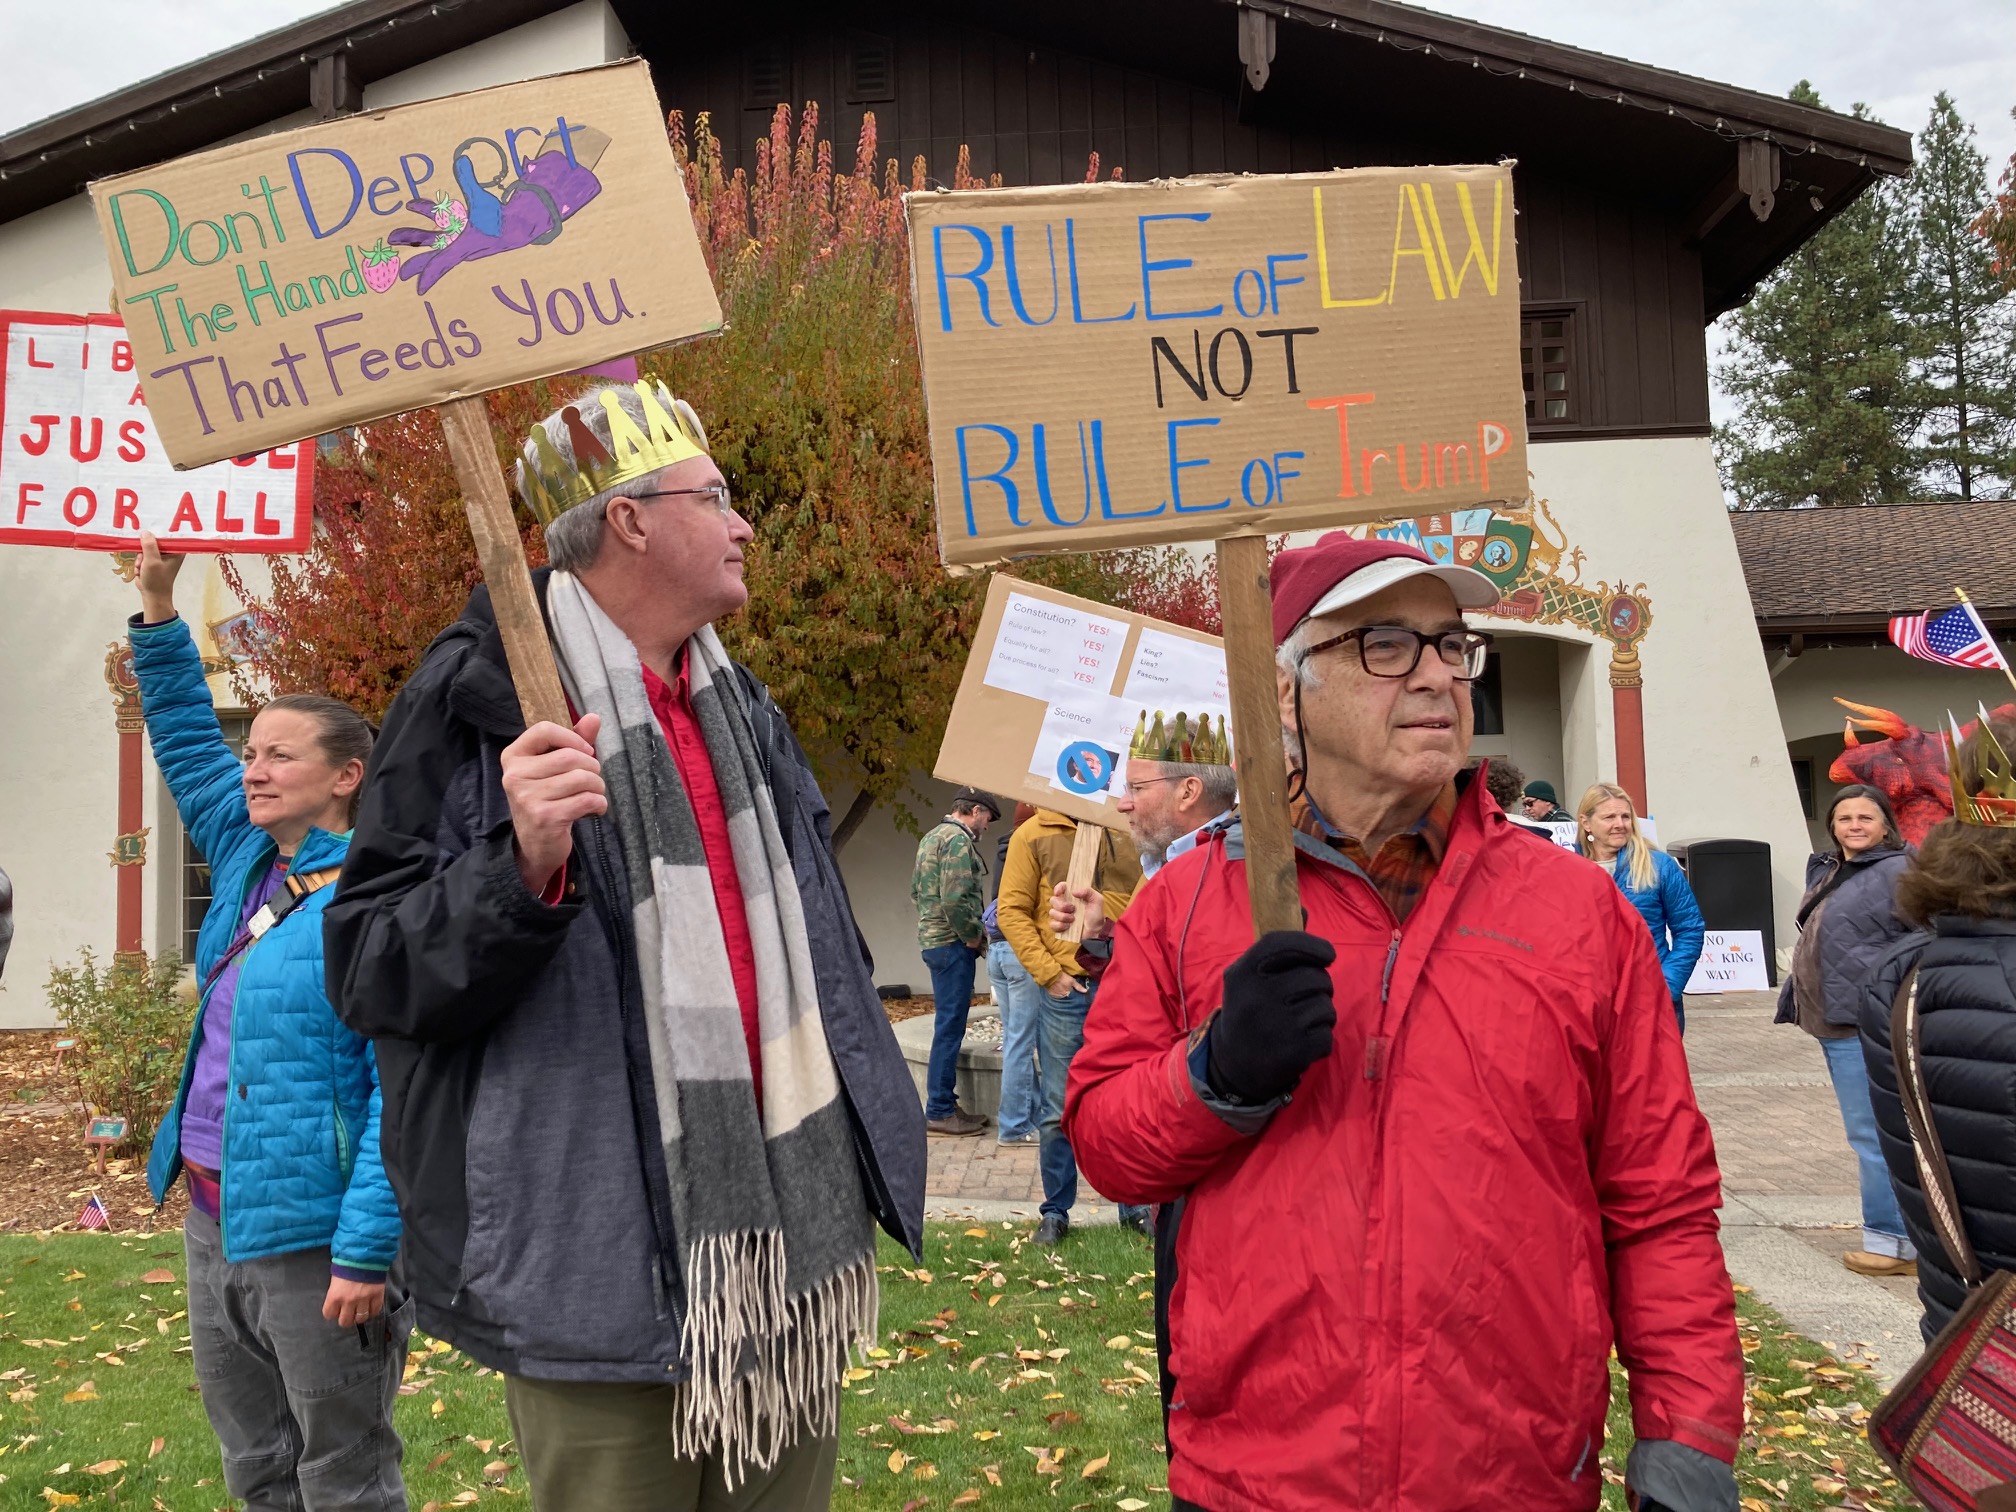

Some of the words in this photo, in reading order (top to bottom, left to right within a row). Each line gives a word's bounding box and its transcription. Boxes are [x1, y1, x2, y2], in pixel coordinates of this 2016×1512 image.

[109, 176, 288, 277] Don't
[932, 212, 1225, 332] RULE
[1312, 179, 1503, 310] LAW
[125, 282, 237, 354] The
[236, 245, 365, 326] Hand
[150, 342, 310, 435] That
[315, 301, 481, 397] Feeds
[1151, 326, 1320, 409] NOT
[955, 418, 1231, 537] RULE
[17, 483, 140, 530] FOR
[169, 491, 281, 535] ALL
[1013, 603, 1076, 627] Constitution?
[1088, 623, 1110, 636] YES!
[1009, 620, 1022, 629] Rule
[1031, 627, 1046, 635] law?
[1083, 639, 1105, 652] YES!
[999, 652, 1012, 661] Due
[1012, 657, 1037, 669] process
[1038, 664, 1047, 672] for
[1048, 667, 1060, 675] all?
[1073, 671, 1095, 684] YES!
[1003, 637, 1029, 650] Equality
[1038, 647, 1051, 655] all?
[1078, 655, 1100, 668] YES!
[1140, 659, 1158, 668] Lies?
[1143, 648, 1162, 658] King?
[1137, 670, 1168, 683] Fascism?
[1212, 691, 1225, 699] No!
[1054, 707, 1092, 725] Science
[1706, 936, 1724, 946] NO
[1722, 952, 1754, 963] KING
[1706, 970, 1737, 980] WAY!
